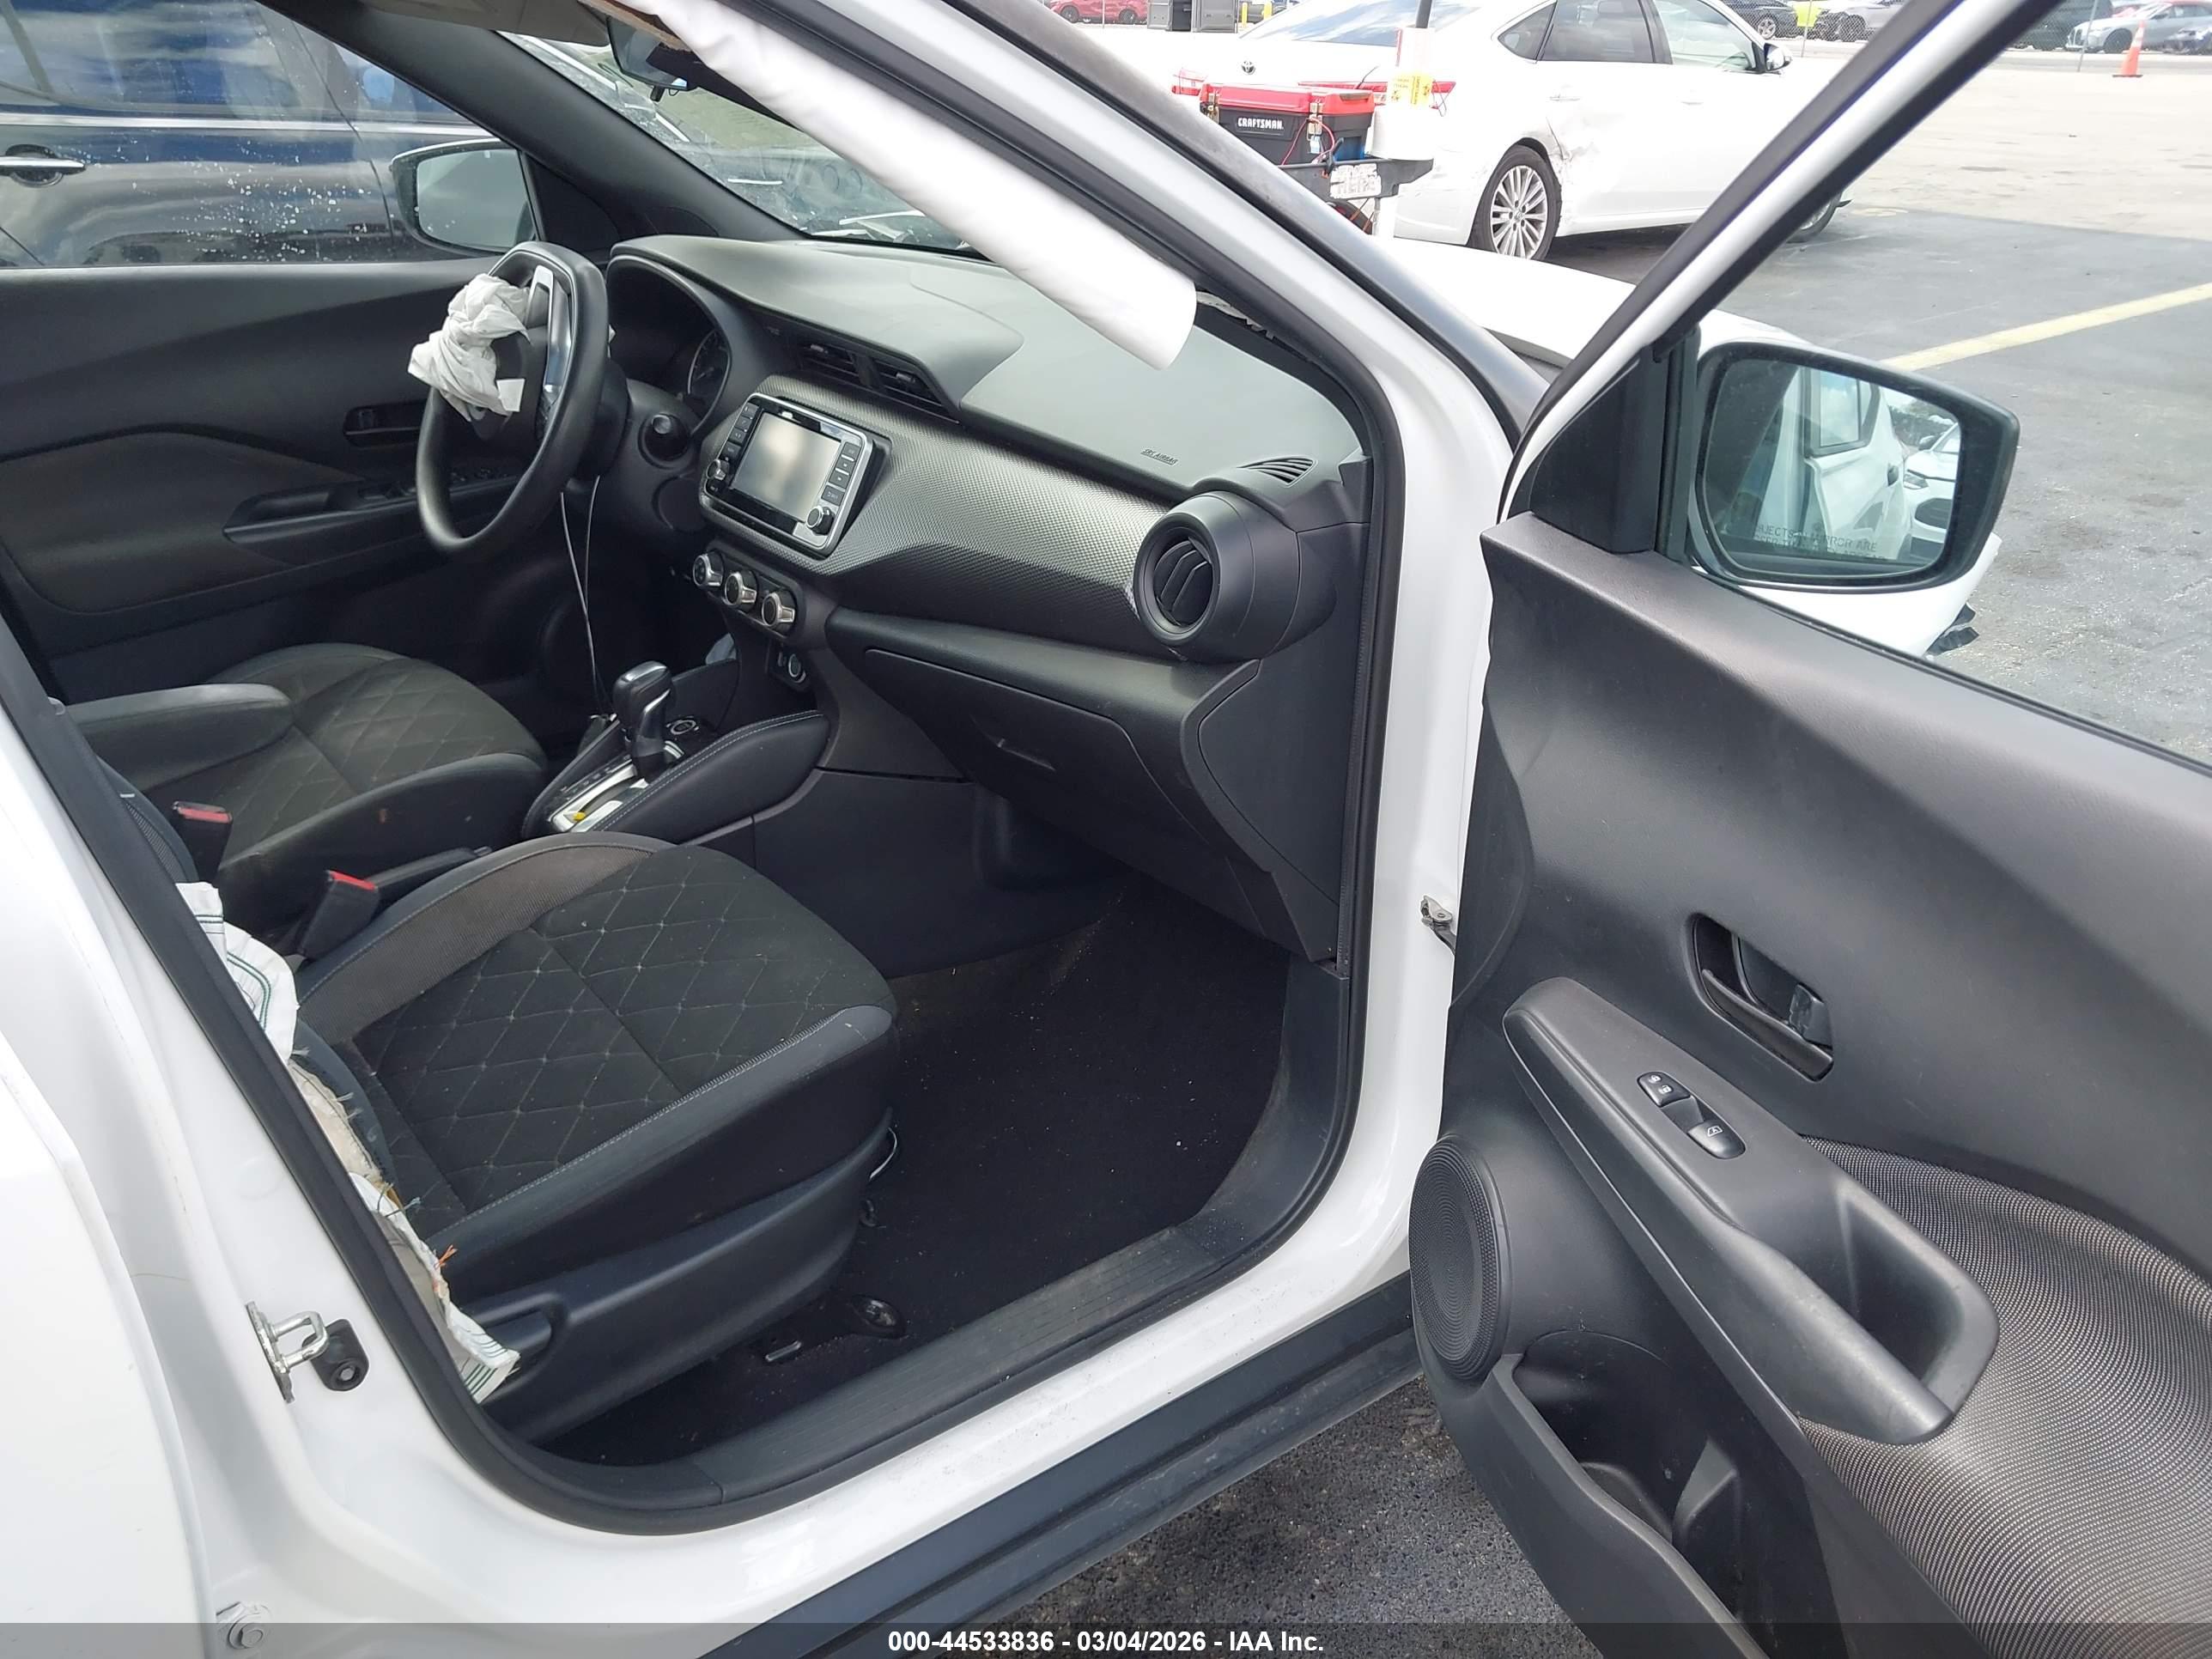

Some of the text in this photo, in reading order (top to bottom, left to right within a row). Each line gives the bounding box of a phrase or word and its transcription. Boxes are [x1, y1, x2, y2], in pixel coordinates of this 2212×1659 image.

[1237, 117, 1284, 130] CRAFTSMAN
[1755, 524, 1794, 538] JECTS
[1856, 539, 1877, 552] ARE
